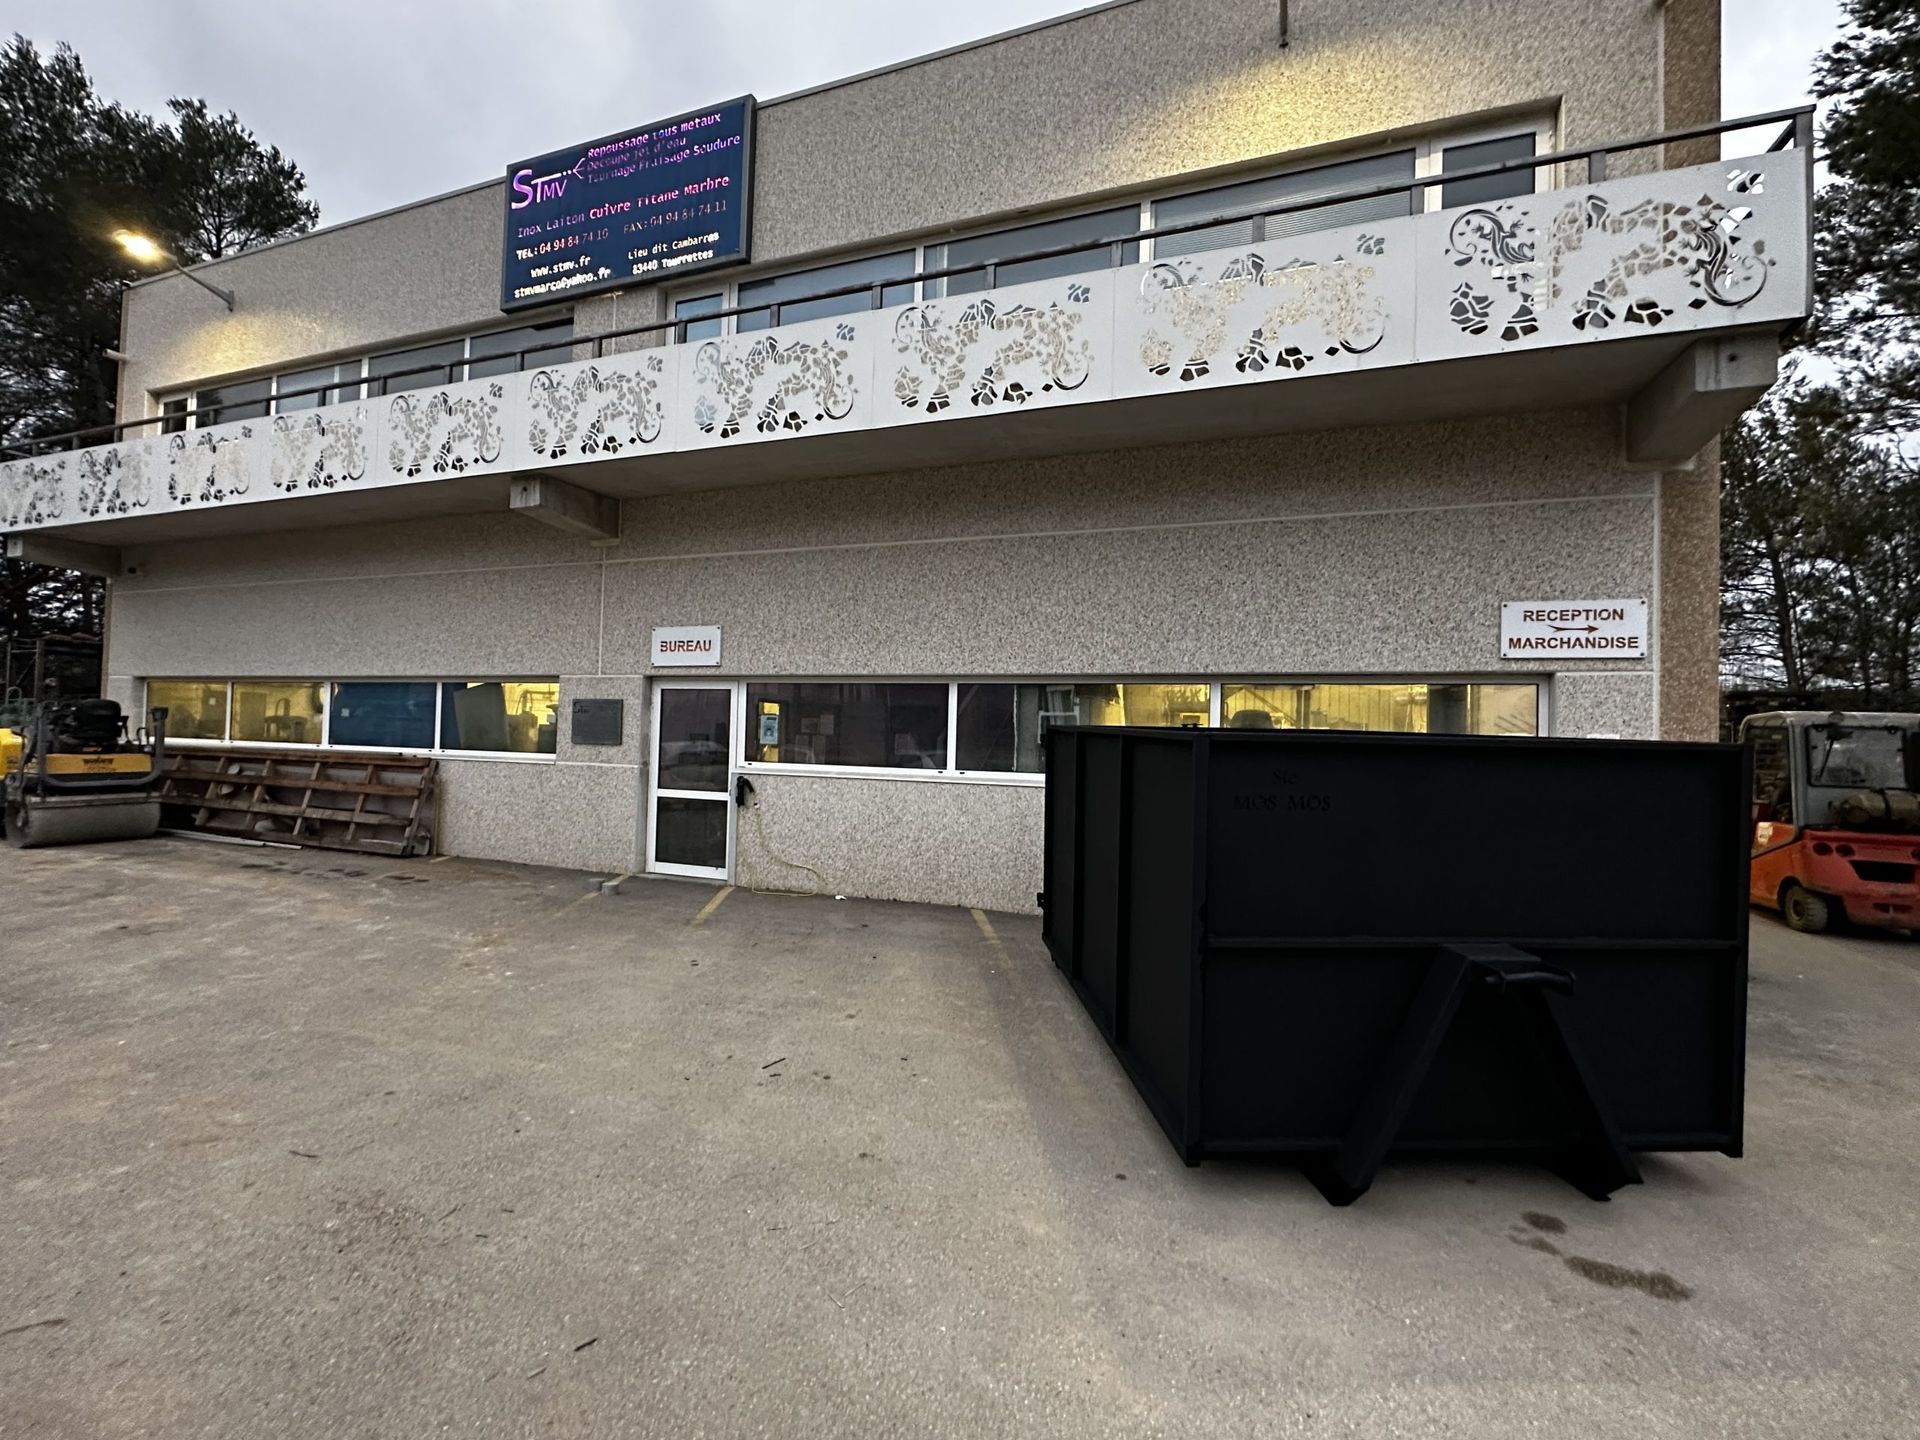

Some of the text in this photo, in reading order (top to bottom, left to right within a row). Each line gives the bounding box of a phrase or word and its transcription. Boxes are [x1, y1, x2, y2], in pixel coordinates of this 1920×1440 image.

[693, 135, 740, 156] Soudure
[518, 176, 729, 239] Inox Laiton Cuivre Titane Marbre
[698, 204, 710, 216] 74
[715, 200, 727, 212] 11
[628, 248, 648, 260] Lieu
[652, 243, 668, 255] dit
[1523, 608, 1624, 622] RECEPTION
[660, 639, 712, 653] BUREAU
[1508, 636, 1639, 649] MARCHANDISE
